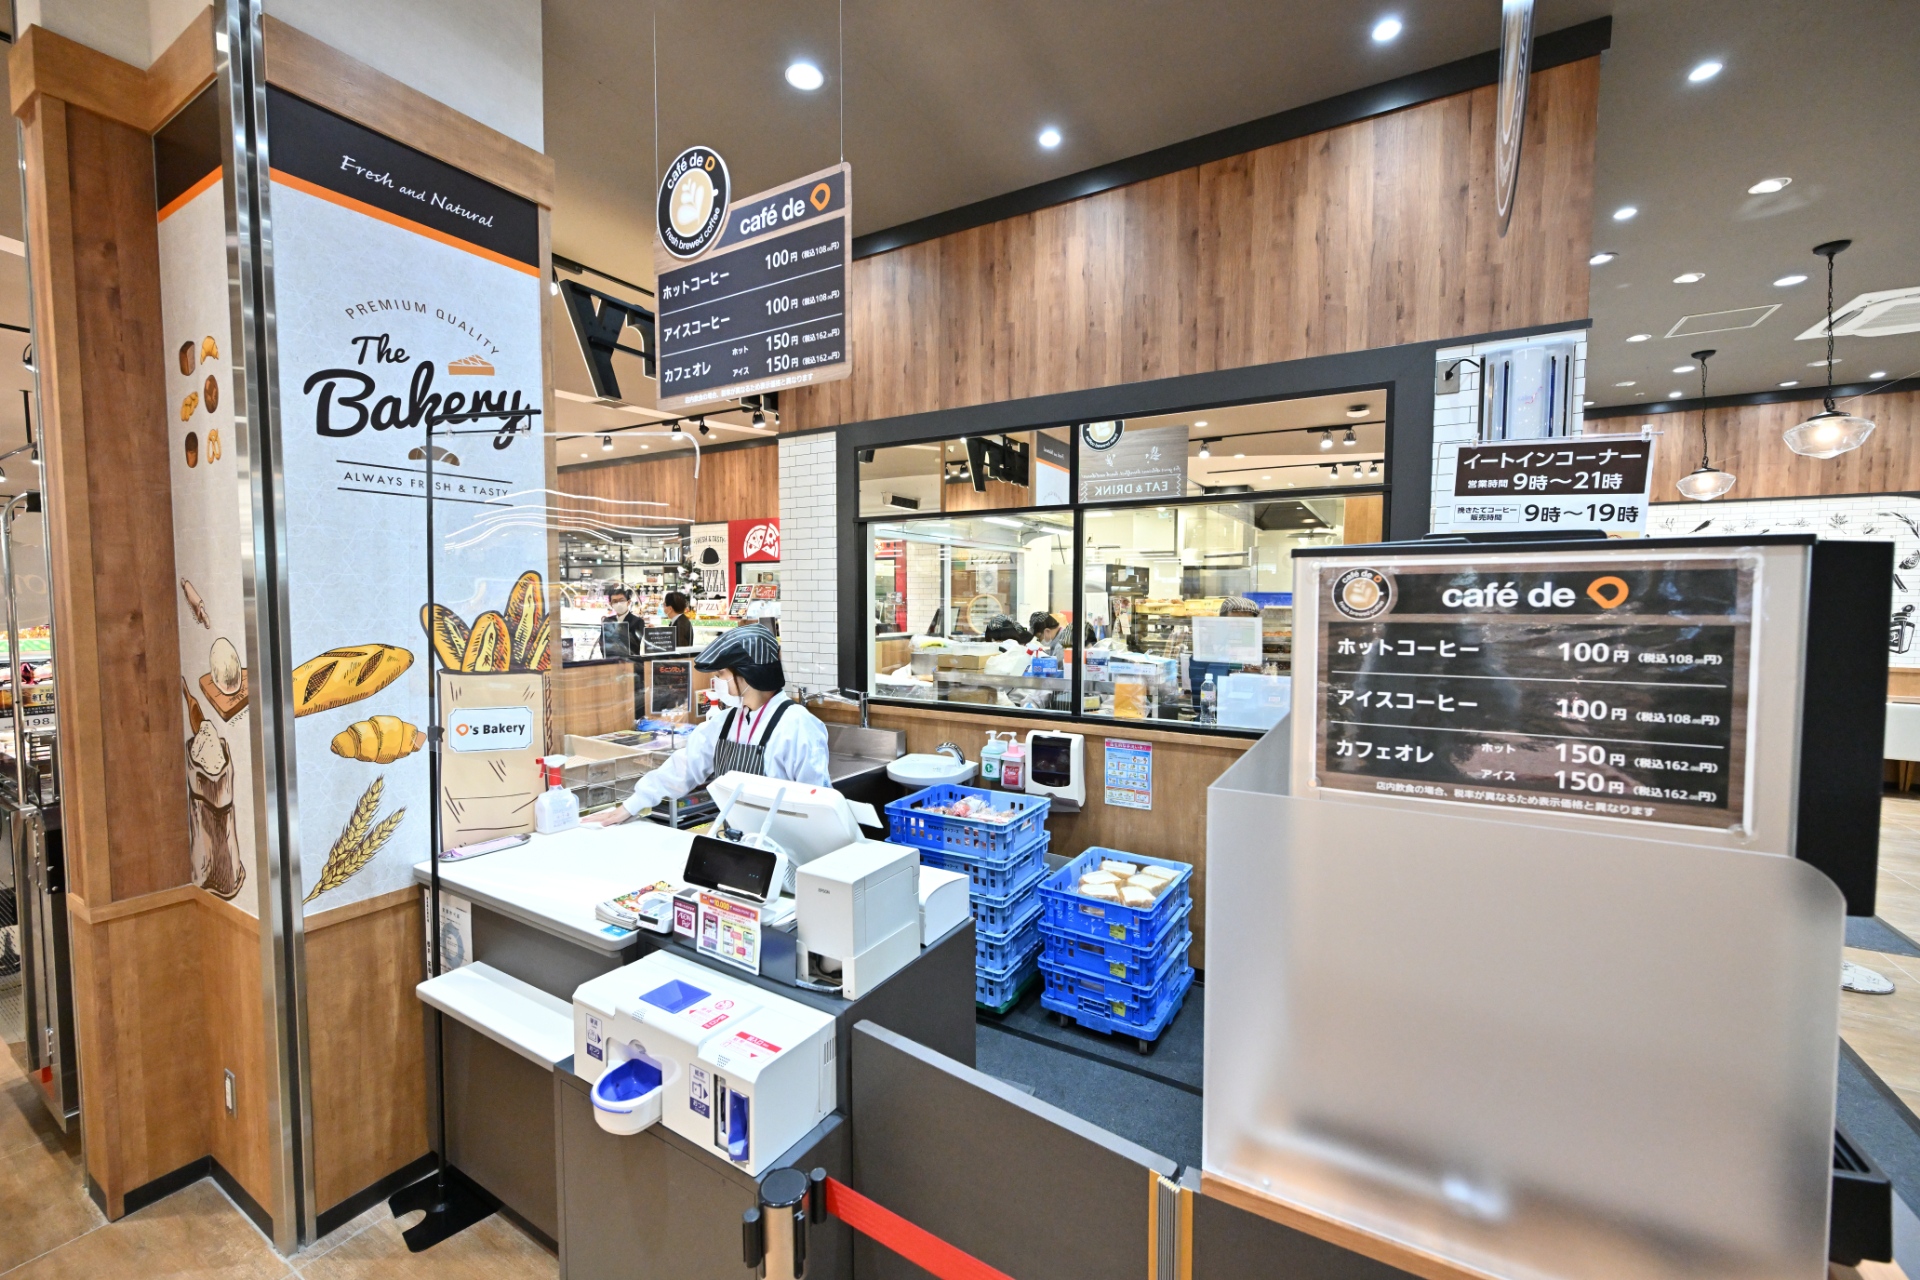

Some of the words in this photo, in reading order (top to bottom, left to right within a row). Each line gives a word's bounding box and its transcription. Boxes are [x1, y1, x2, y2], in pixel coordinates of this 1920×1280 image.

[667, 157, 688, 190] café
[689, 152, 704, 167] de
[340, 155, 394, 188] Fresh
[399, 186, 425, 201] and
[430, 192, 493, 228] Natural
[665, 227, 679, 248] fresh
[678, 234, 704, 250] brewed
[703, 207, 720, 238] coffee
[739, 203, 777, 235] café
[782, 198, 806, 221] de
[662, 271, 730, 300] ホットコーヒー
[765, 249, 798, 270] 100円
[345, 299, 427, 319] PREMIUM
[436, 309, 499, 355] QUALITY
[663, 316, 731, 342] アイスコーヒー
[765, 295, 798, 316] 100円
[351, 333, 410, 365] The
[664, 361, 711, 383] カフェオレ
[732, 345, 749, 356] ホット
[766, 332, 799, 352] 150円
[732, 366, 750, 377] アイス
[766, 354, 799, 373] 150円
[303, 360, 532, 450] Bakery
[1464, 448, 1642, 470] イートインコーナー
[344, 471, 403, 486] ALWAYS
[410, 479, 451, 492] FRSH
[458, 484, 466, 493] &
[472, 486, 509, 497] TASTY
[1467, 479, 1508, 489] 営業時間
[1457, 506, 1518, 514] 挽きたてコーヒー
[1342, 570, 1360, 584] café
[1360, 570, 1373, 578] de
[698, 603, 720, 611] PZZA
[1441, 582, 1519, 608] café
[1527, 582, 1577, 608] de
[1337, 638, 1480, 658] ホットコーヒー
[1557, 642, 1630, 663] 100円
[1337, 689, 1478, 712] アイスコーヒー
[1556, 698, 1628, 720] 100円
[25, 717, 50, 726] 198
[483, 723, 526, 736] Bakery
[1336, 740, 1434, 763] カフェオレ
[1481, 743, 1516, 754] ホット
[1554, 743, 1626, 767] 150円
[1480, 769, 1516, 782] アイス
[1553, 770, 1625, 794] 150円
